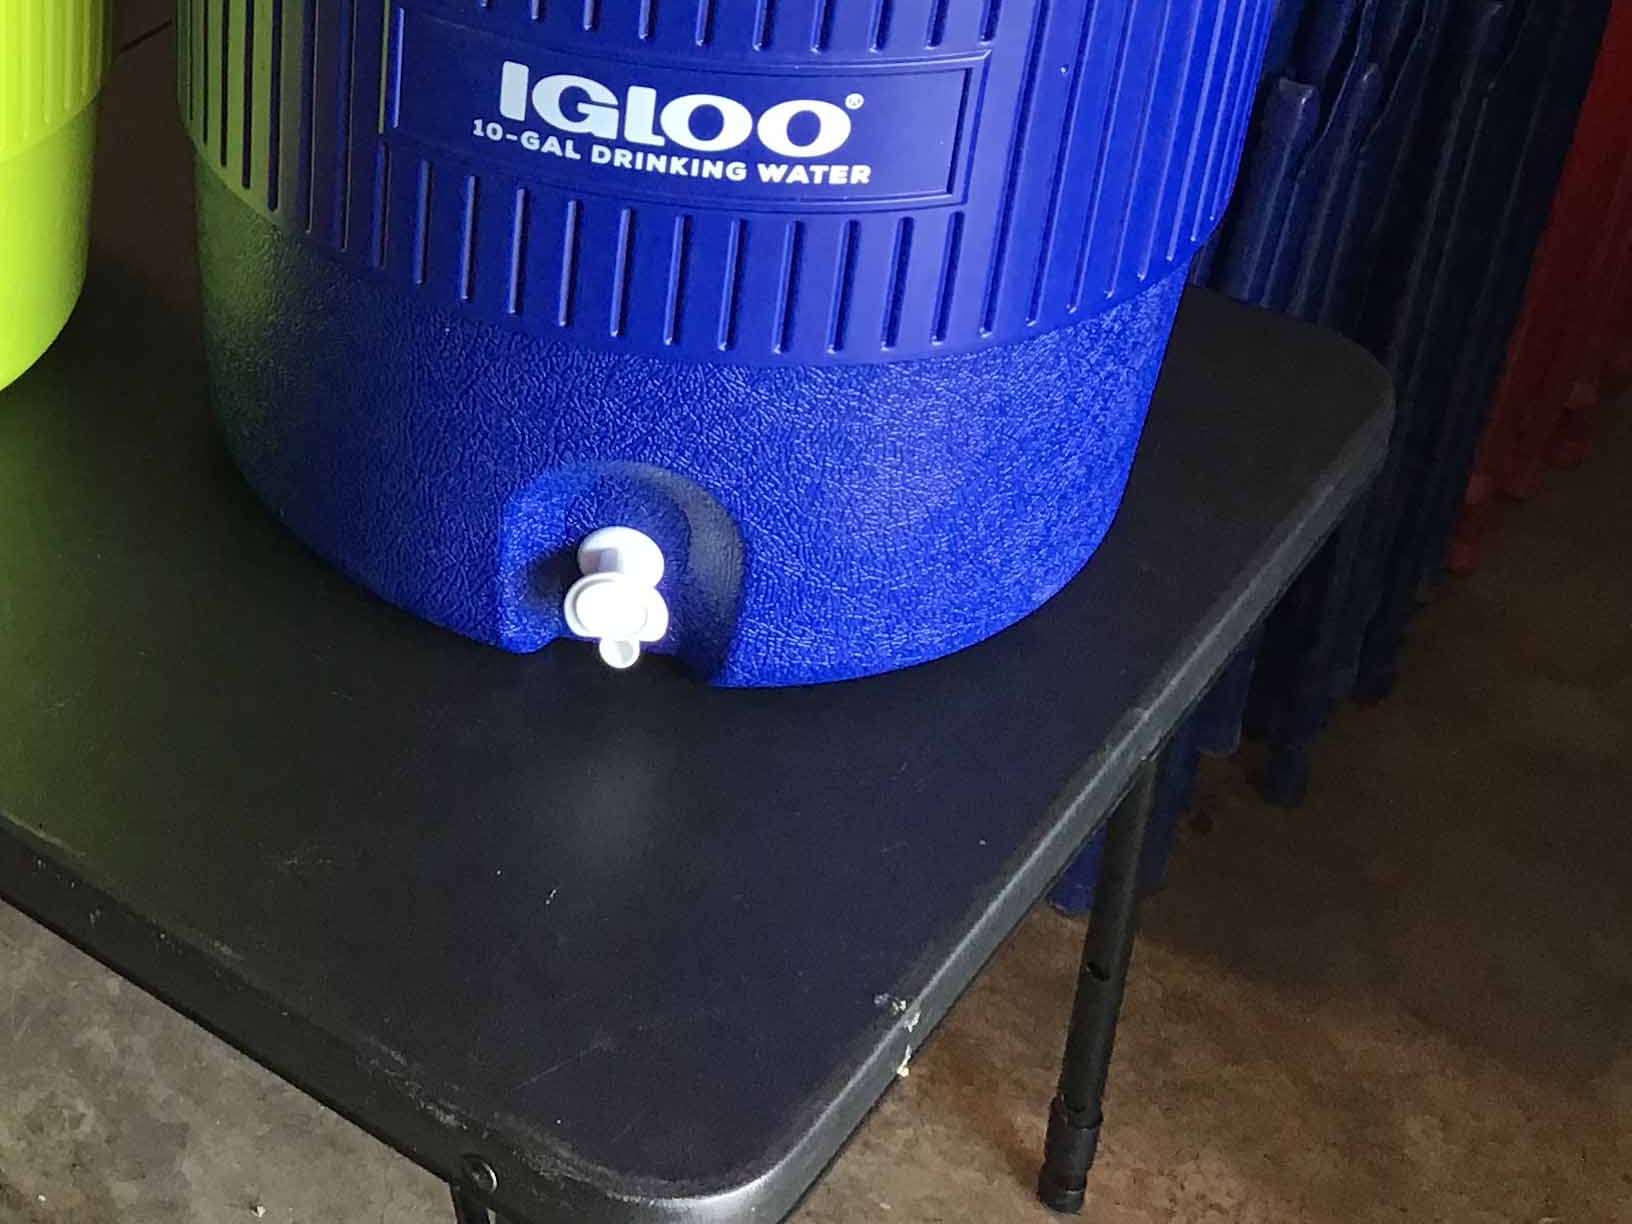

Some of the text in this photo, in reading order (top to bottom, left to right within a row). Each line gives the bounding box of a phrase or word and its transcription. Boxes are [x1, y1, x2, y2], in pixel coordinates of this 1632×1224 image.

[499, 60, 853, 158] IGLOO
[473, 119, 872, 185] 10-GAL DRINKING WATER
